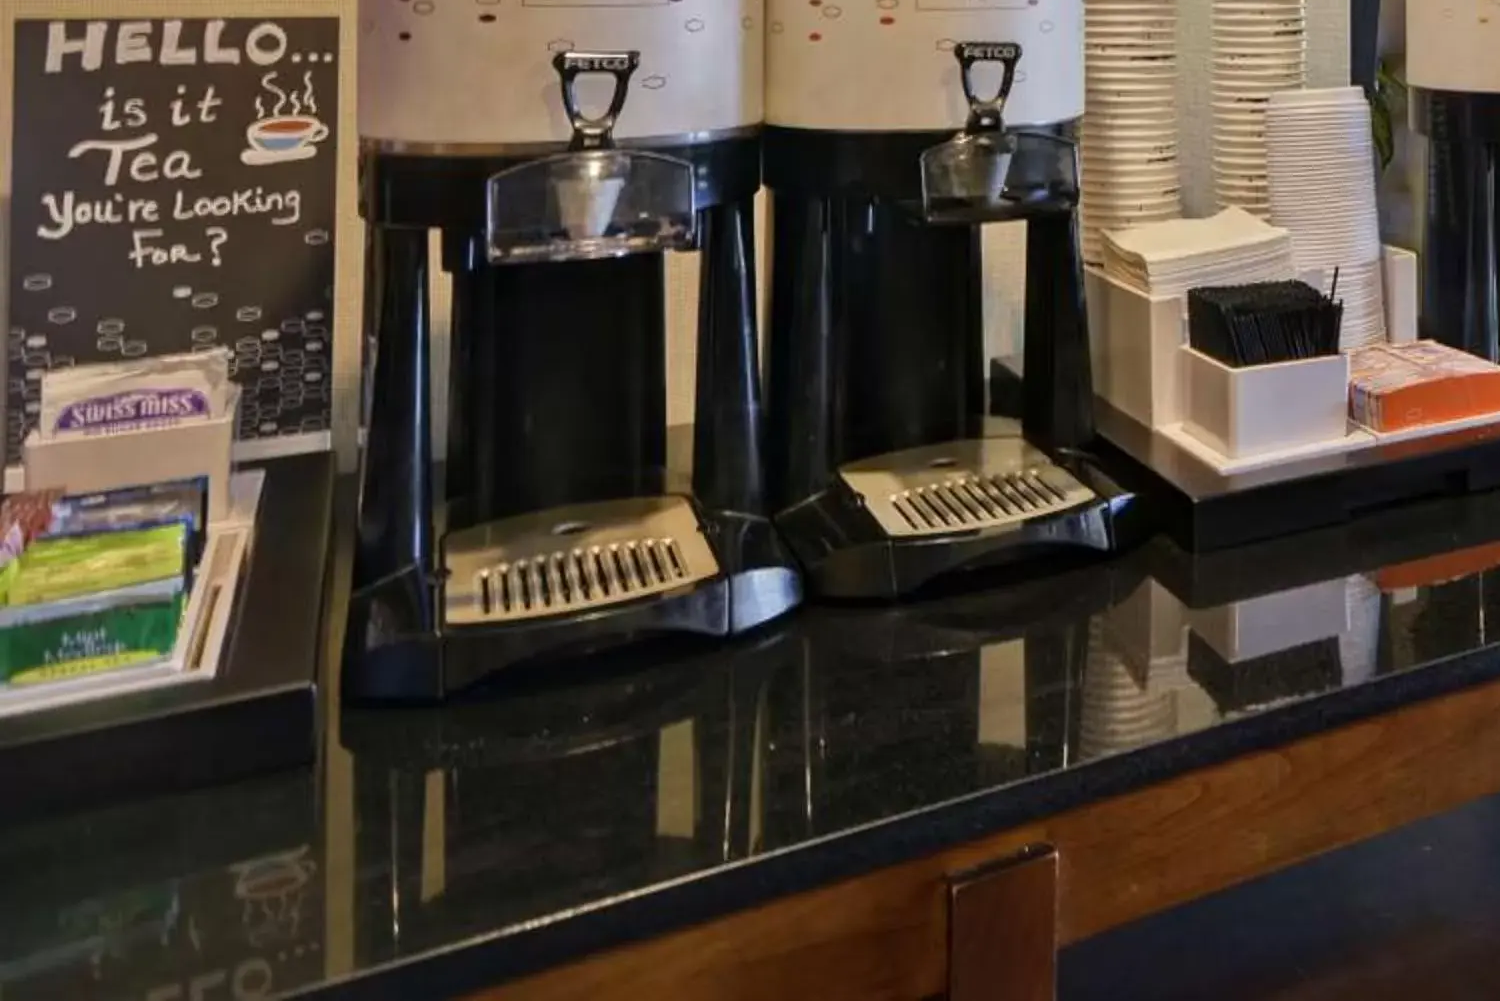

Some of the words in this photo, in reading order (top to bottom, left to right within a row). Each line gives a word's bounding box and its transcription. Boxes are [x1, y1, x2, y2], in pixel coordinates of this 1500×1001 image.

[564, 57, 629, 70] FETCO
[964, 46, 1016, 59] FETCO
[100, 86, 148, 130] is
[171, 84, 223, 126] it
[68, 133, 203, 186] Tea
